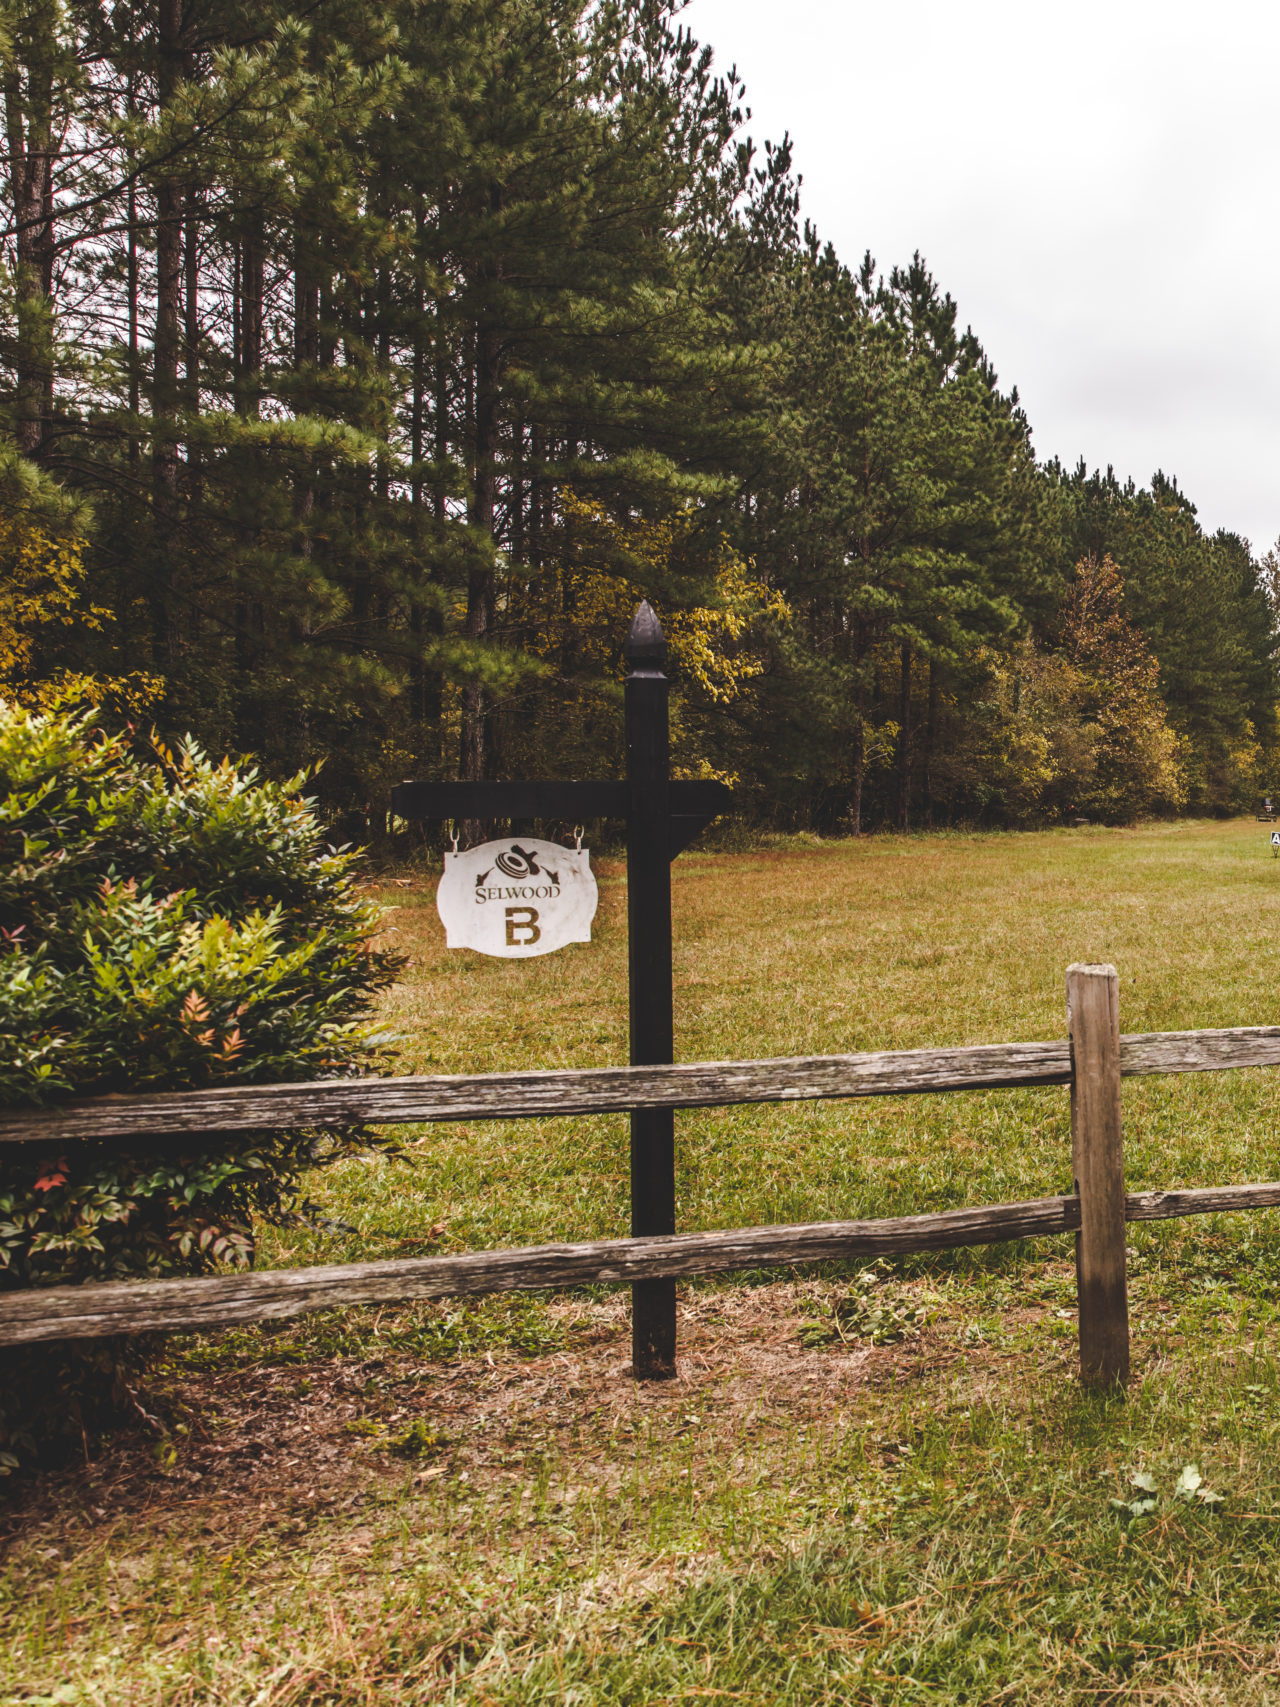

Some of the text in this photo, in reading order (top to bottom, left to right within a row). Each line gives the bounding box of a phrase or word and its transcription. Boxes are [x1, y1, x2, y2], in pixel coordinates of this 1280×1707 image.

[1271, 833, 1280, 844] A
[475, 886, 561, 904] SELWOOD
[505, 907, 541, 946] B
